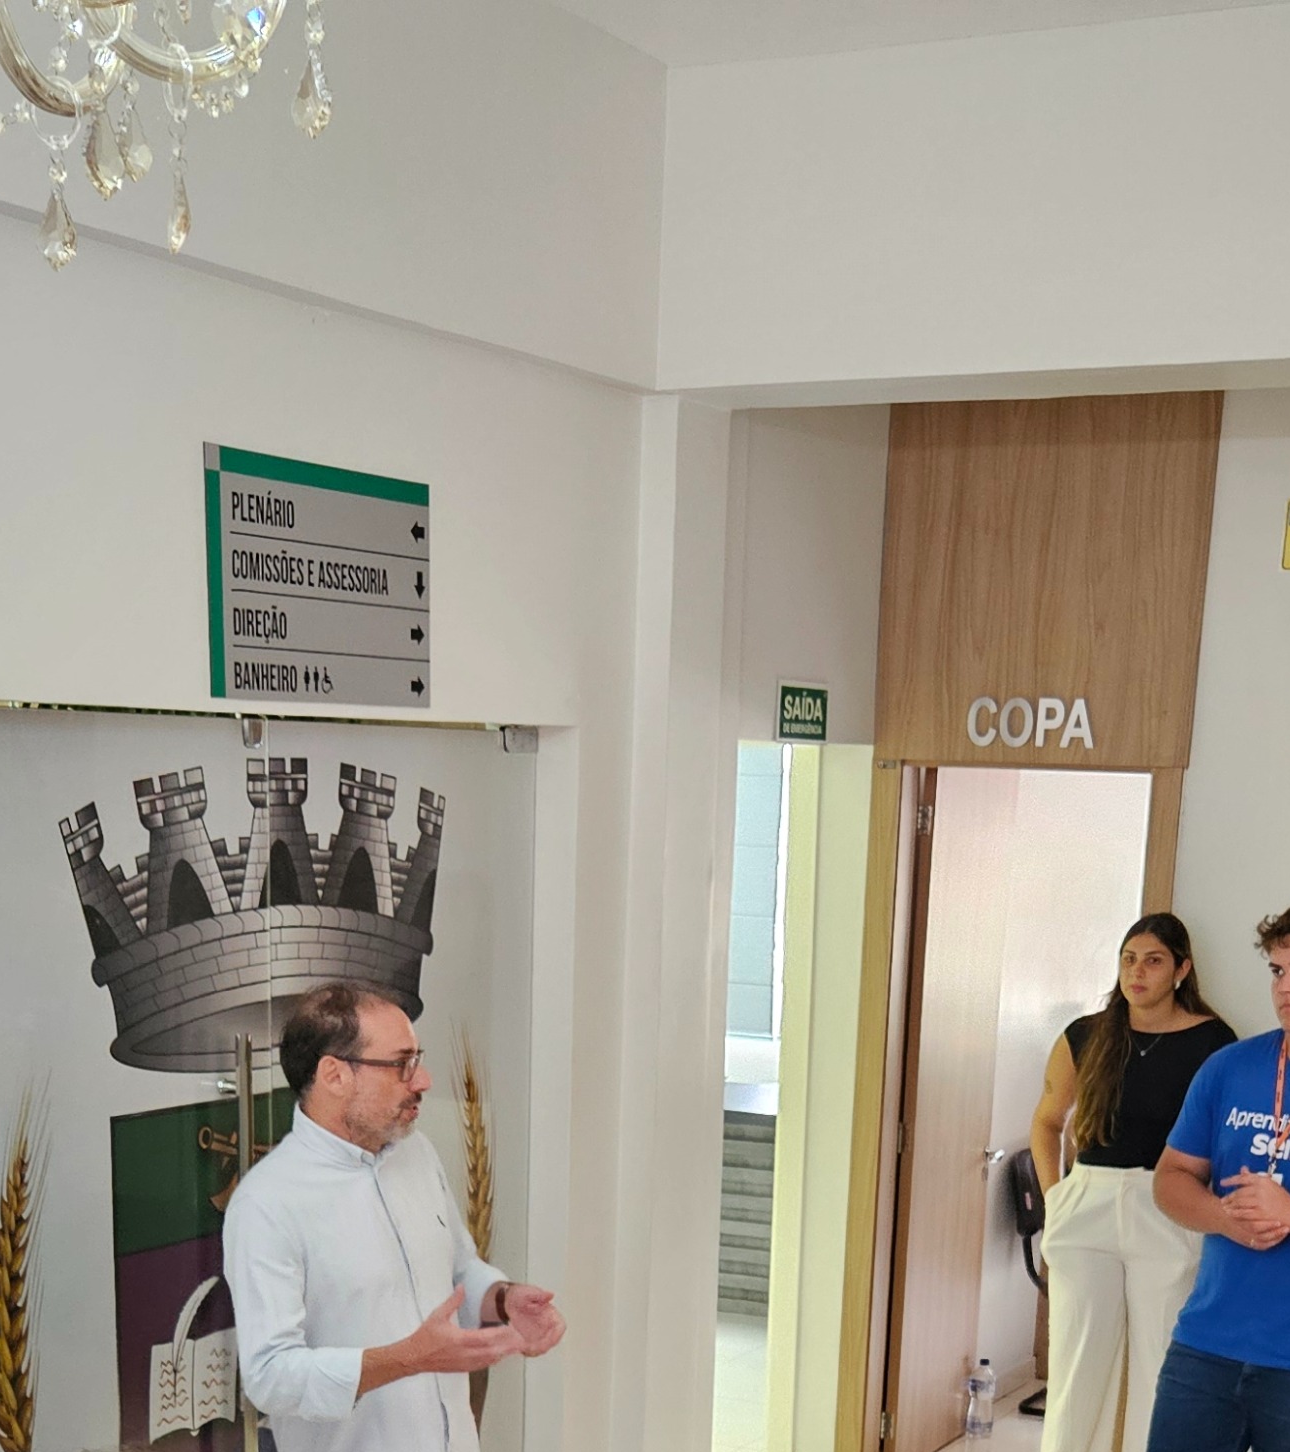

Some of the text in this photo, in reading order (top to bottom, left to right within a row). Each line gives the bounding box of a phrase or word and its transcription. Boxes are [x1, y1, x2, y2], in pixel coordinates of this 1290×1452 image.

[231, 491, 295, 528] PLENÁRIO
[231, 549, 389, 596] COMISSÕES E ASSESSORIA
[232, 604, 288, 644] DIREÇÃO
[233, 661, 298, 693] BANHEIRO
[783, 690, 823, 723] SAÍDA
[966, 696, 1095, 750] COPA
